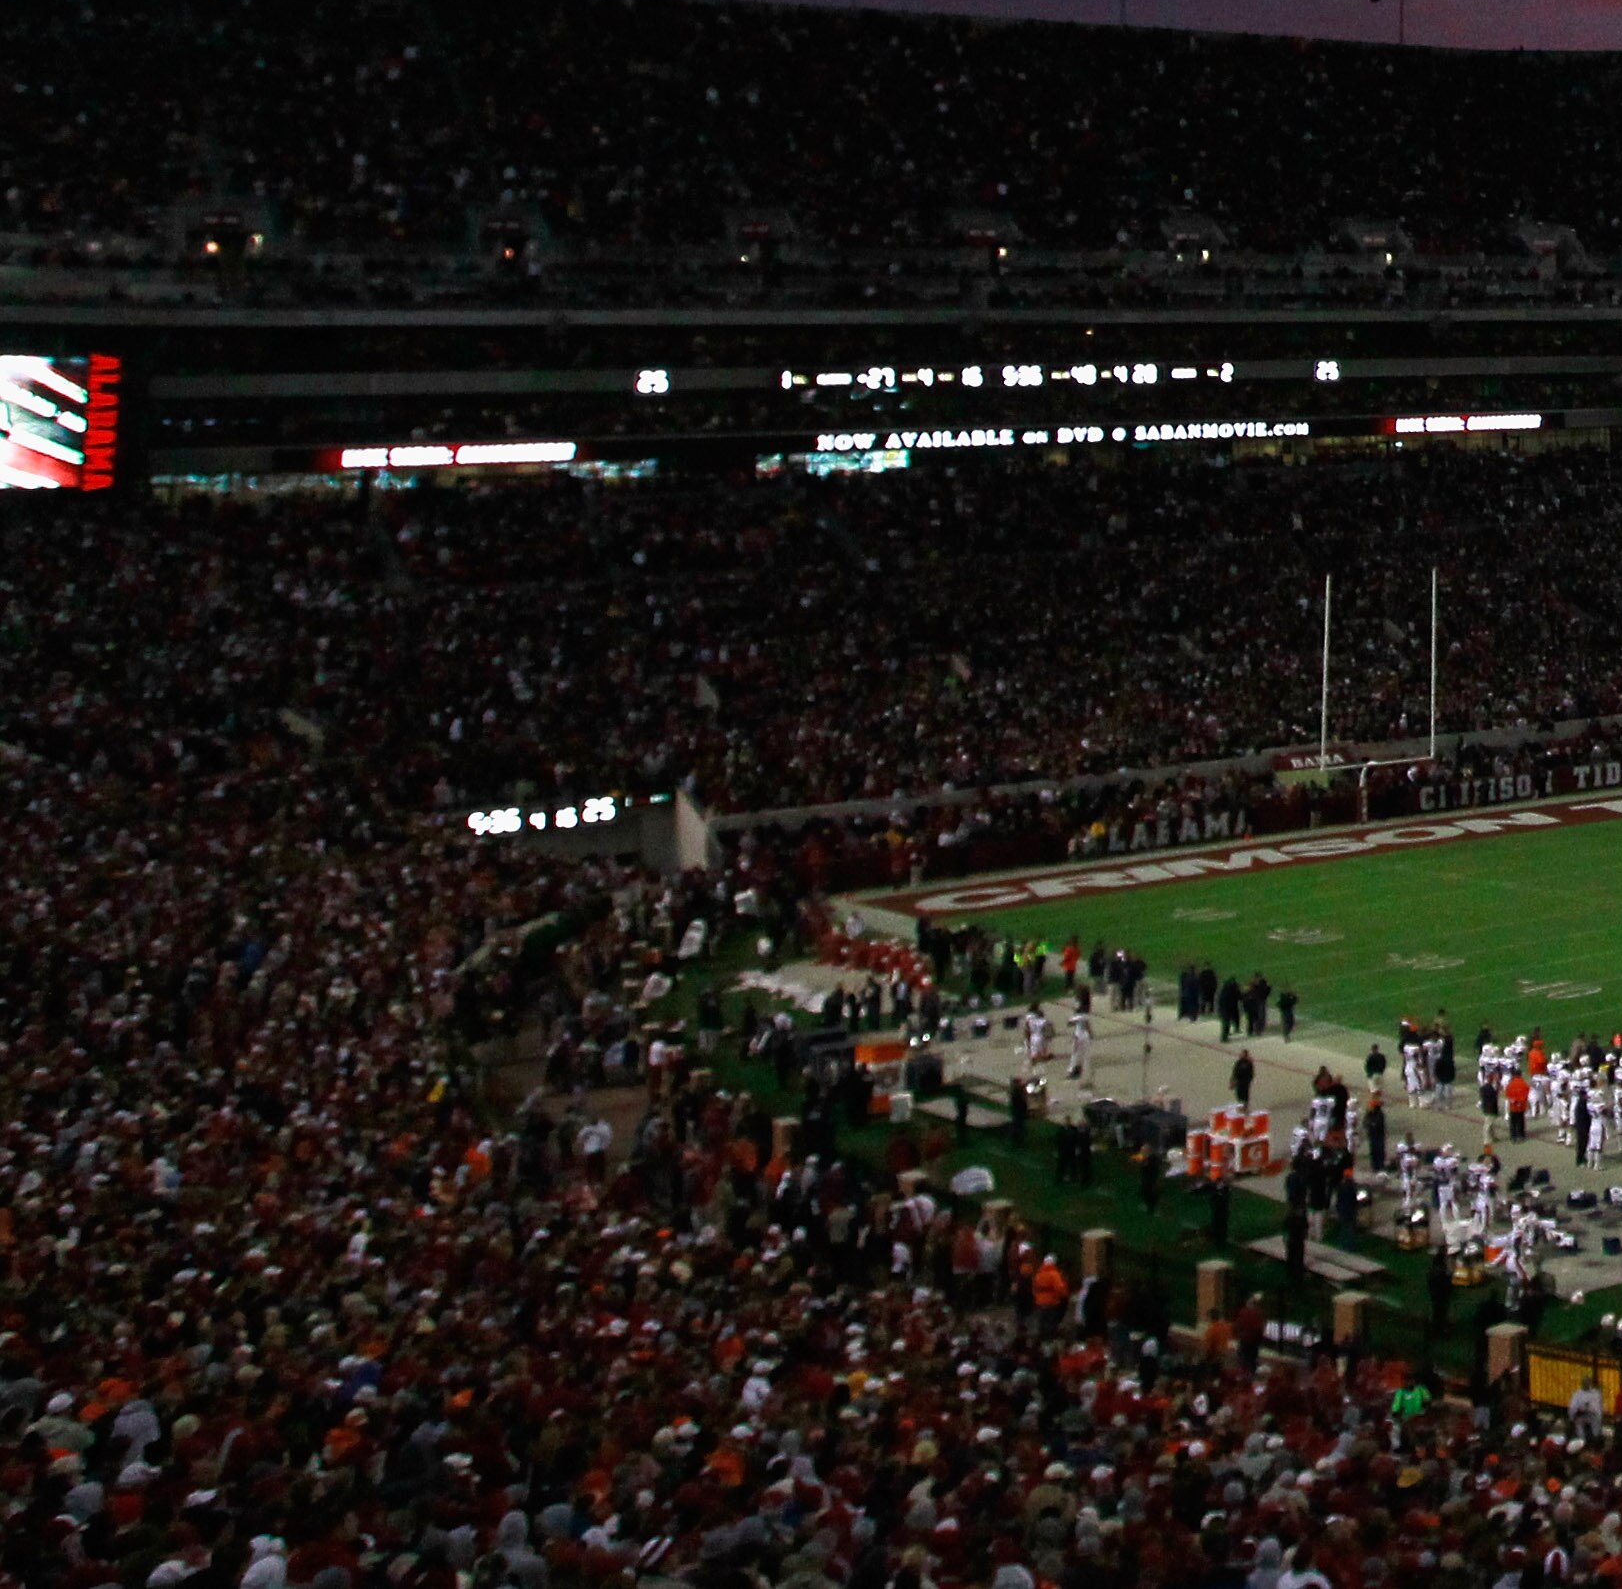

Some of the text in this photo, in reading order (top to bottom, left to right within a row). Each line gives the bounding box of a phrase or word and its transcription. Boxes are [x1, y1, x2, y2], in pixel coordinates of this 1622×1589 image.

[816, 433, 877, 452] NOW
[885, 429, 1015, 450] AVAILABLE
[1057, 426, 1105, 444] DVD
[915, 812, 1561, 912] CRIMSON
